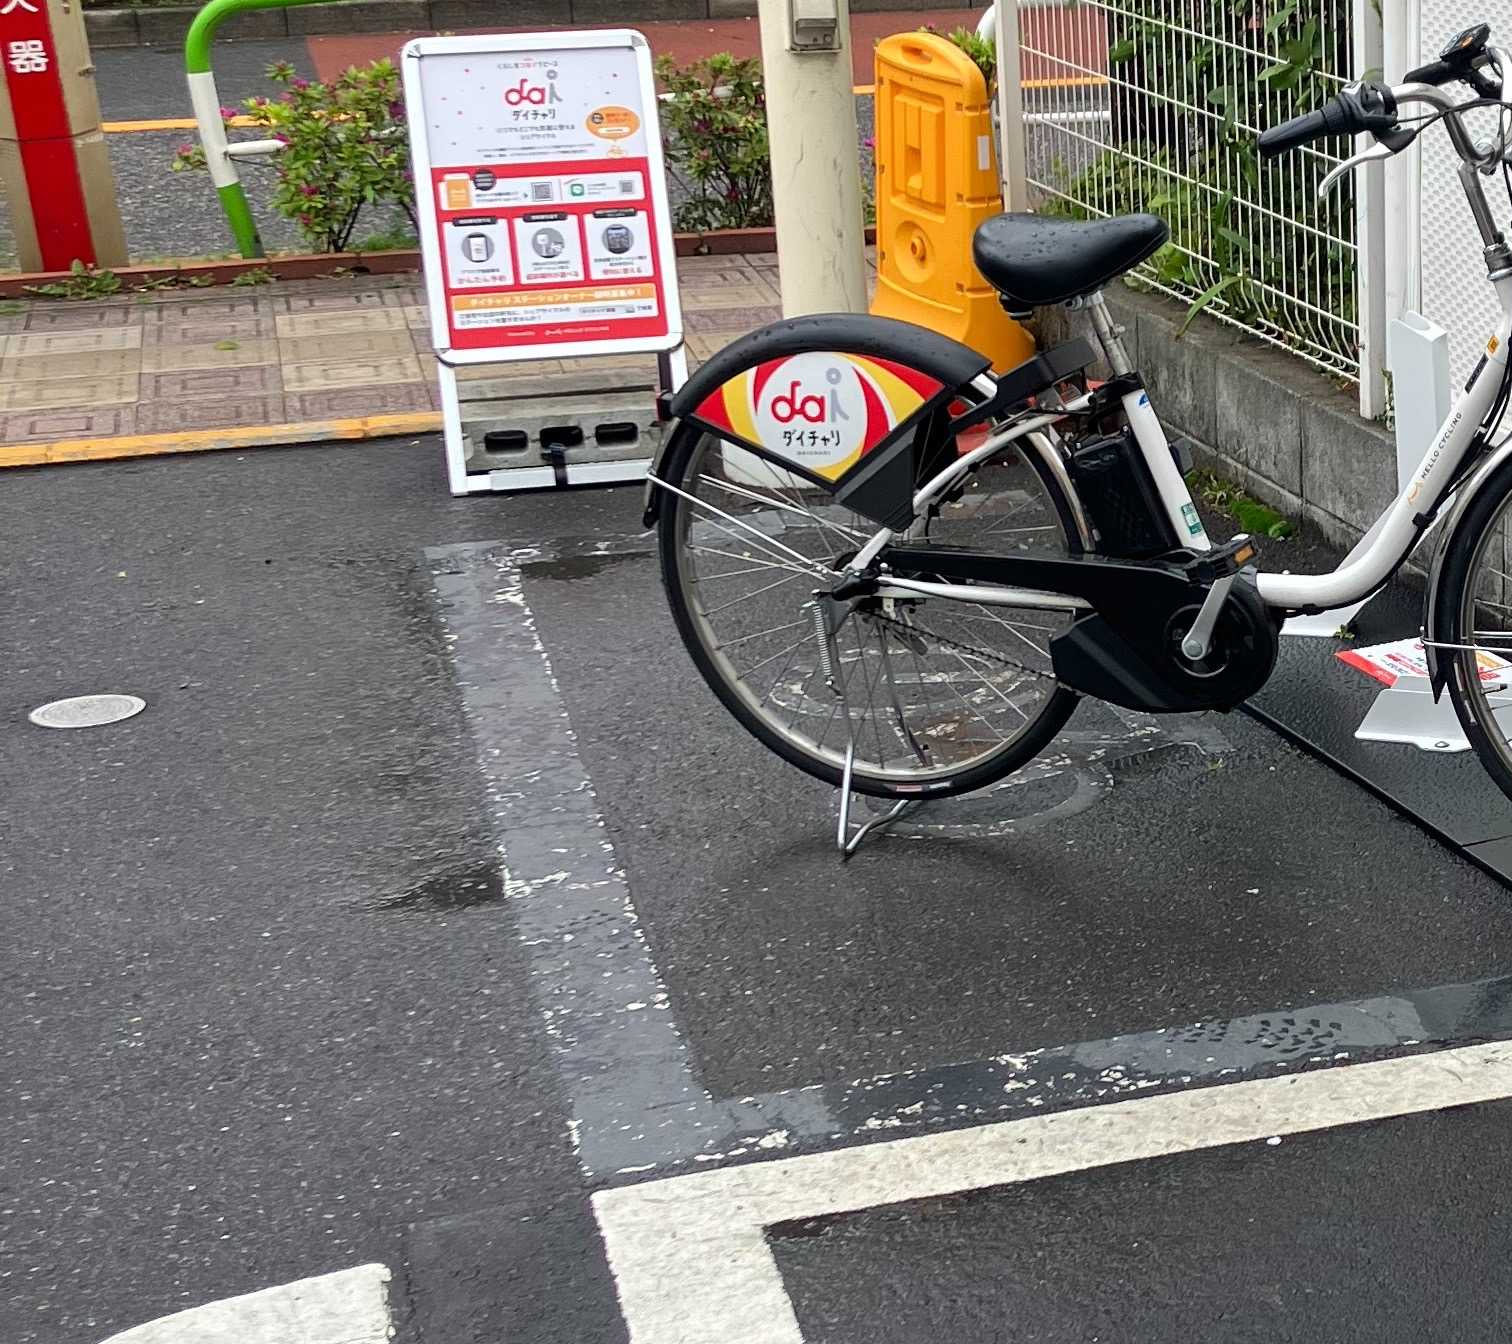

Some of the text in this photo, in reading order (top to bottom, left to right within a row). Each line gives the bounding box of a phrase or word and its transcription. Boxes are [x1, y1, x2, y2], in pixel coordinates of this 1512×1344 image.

[512, 108, 556, 121] ダイチャリ
[783, 430, 841, 447] ダイチャリ
[1421, 412, 1463, 480] HELLO CYCLING
